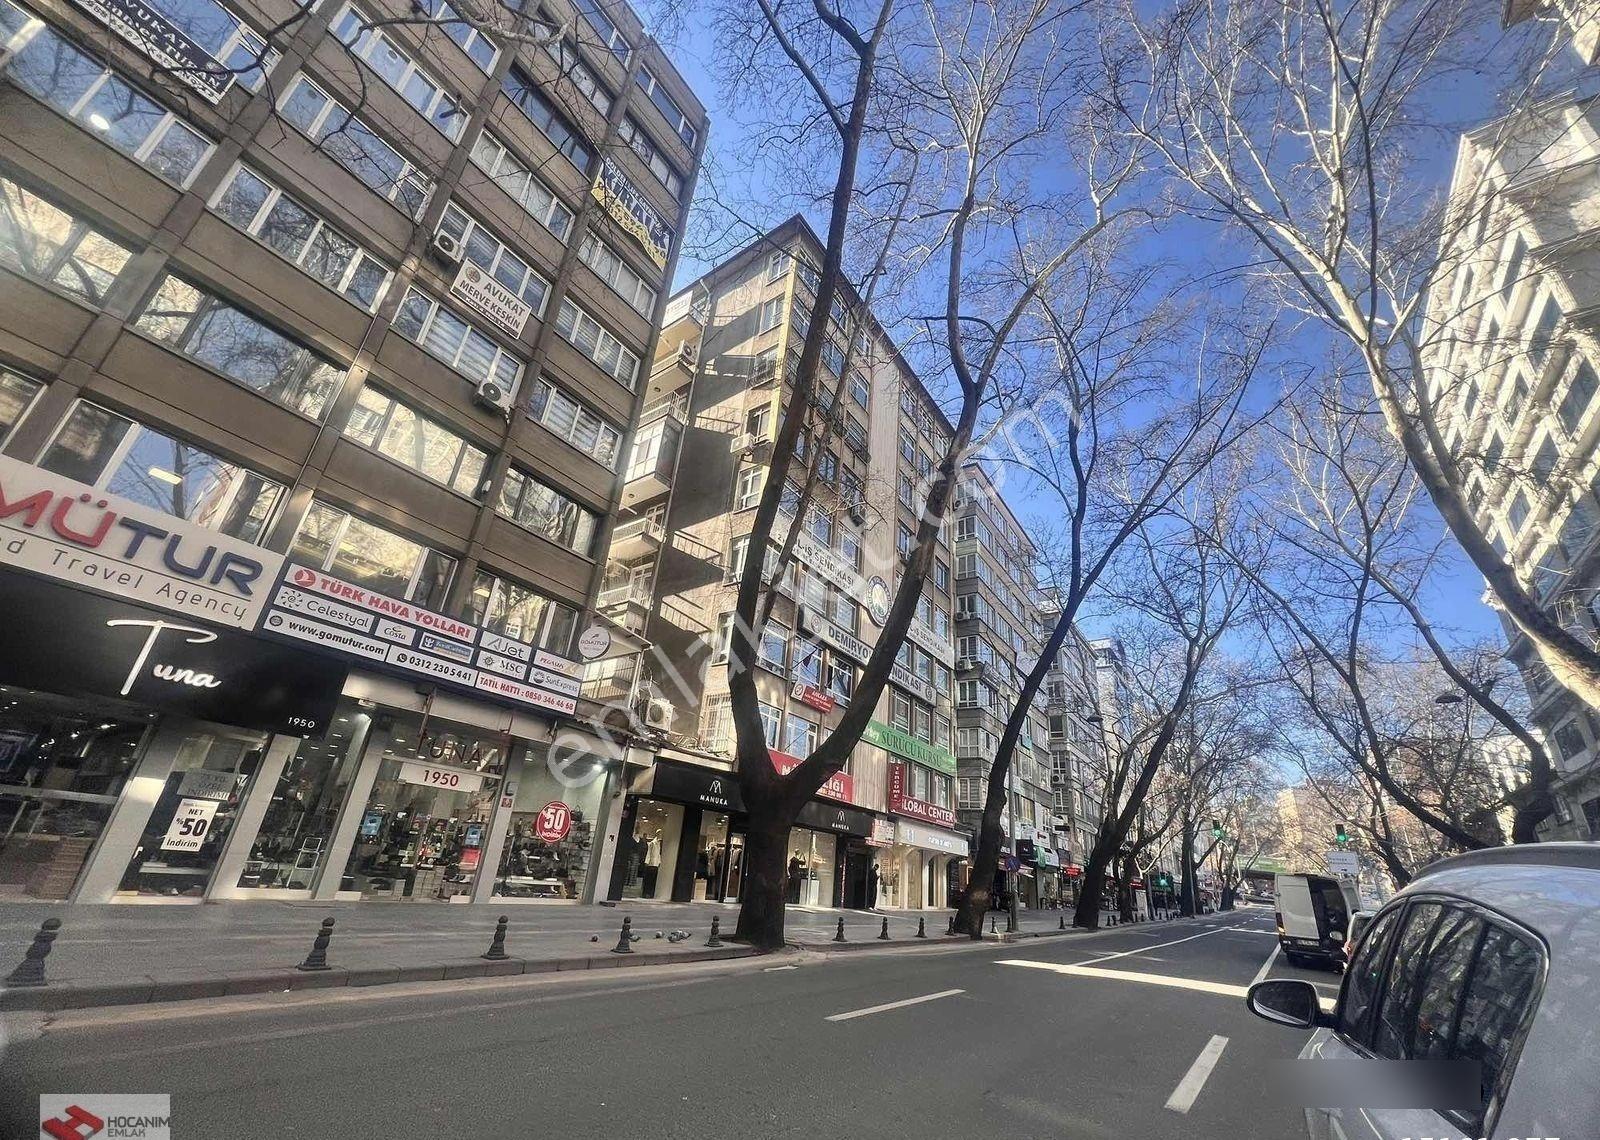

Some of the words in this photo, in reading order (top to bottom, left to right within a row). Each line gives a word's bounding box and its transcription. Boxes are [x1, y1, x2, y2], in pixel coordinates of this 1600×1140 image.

[125, 0, 190, 51] VUKAT
[460, 280, 491, 308] MERVE
[490, 302, 521, 330] KESKİN
[484, 282, 525, 316] AVUKAT
[51, 549, 144, 589] Travel
[156, 582, 249, 621] Agency
[307, 600, 369, 627] Celestyal
[321, 578, 366, 603] TÜRK
[368, 595, 410, 619] HAVA
[414, 611, 471, 638] YOLLARI
[288, 621, 385, 655] www.gomutur.com
[384, 627, 406, 640] Costa
[107, 619, 222, 696] Tuna
[409, 656, 431, 669] 0312
[433, 663, 449, 674] 230
[500, 659, 523, 675] MSC
[545, 675, 578, 693] SunExpress
[892, 666, 921, 692] NDİKASI
[288, 717, 315, 729] 1950
[424, 769, 459, 787] 1950
[188, 808, 204, 816] NET
[700, 794, 728, 806] MANUKA
[902, 798, 927, 816] LOBAL
[928, 805, 955, 823] CENTER
